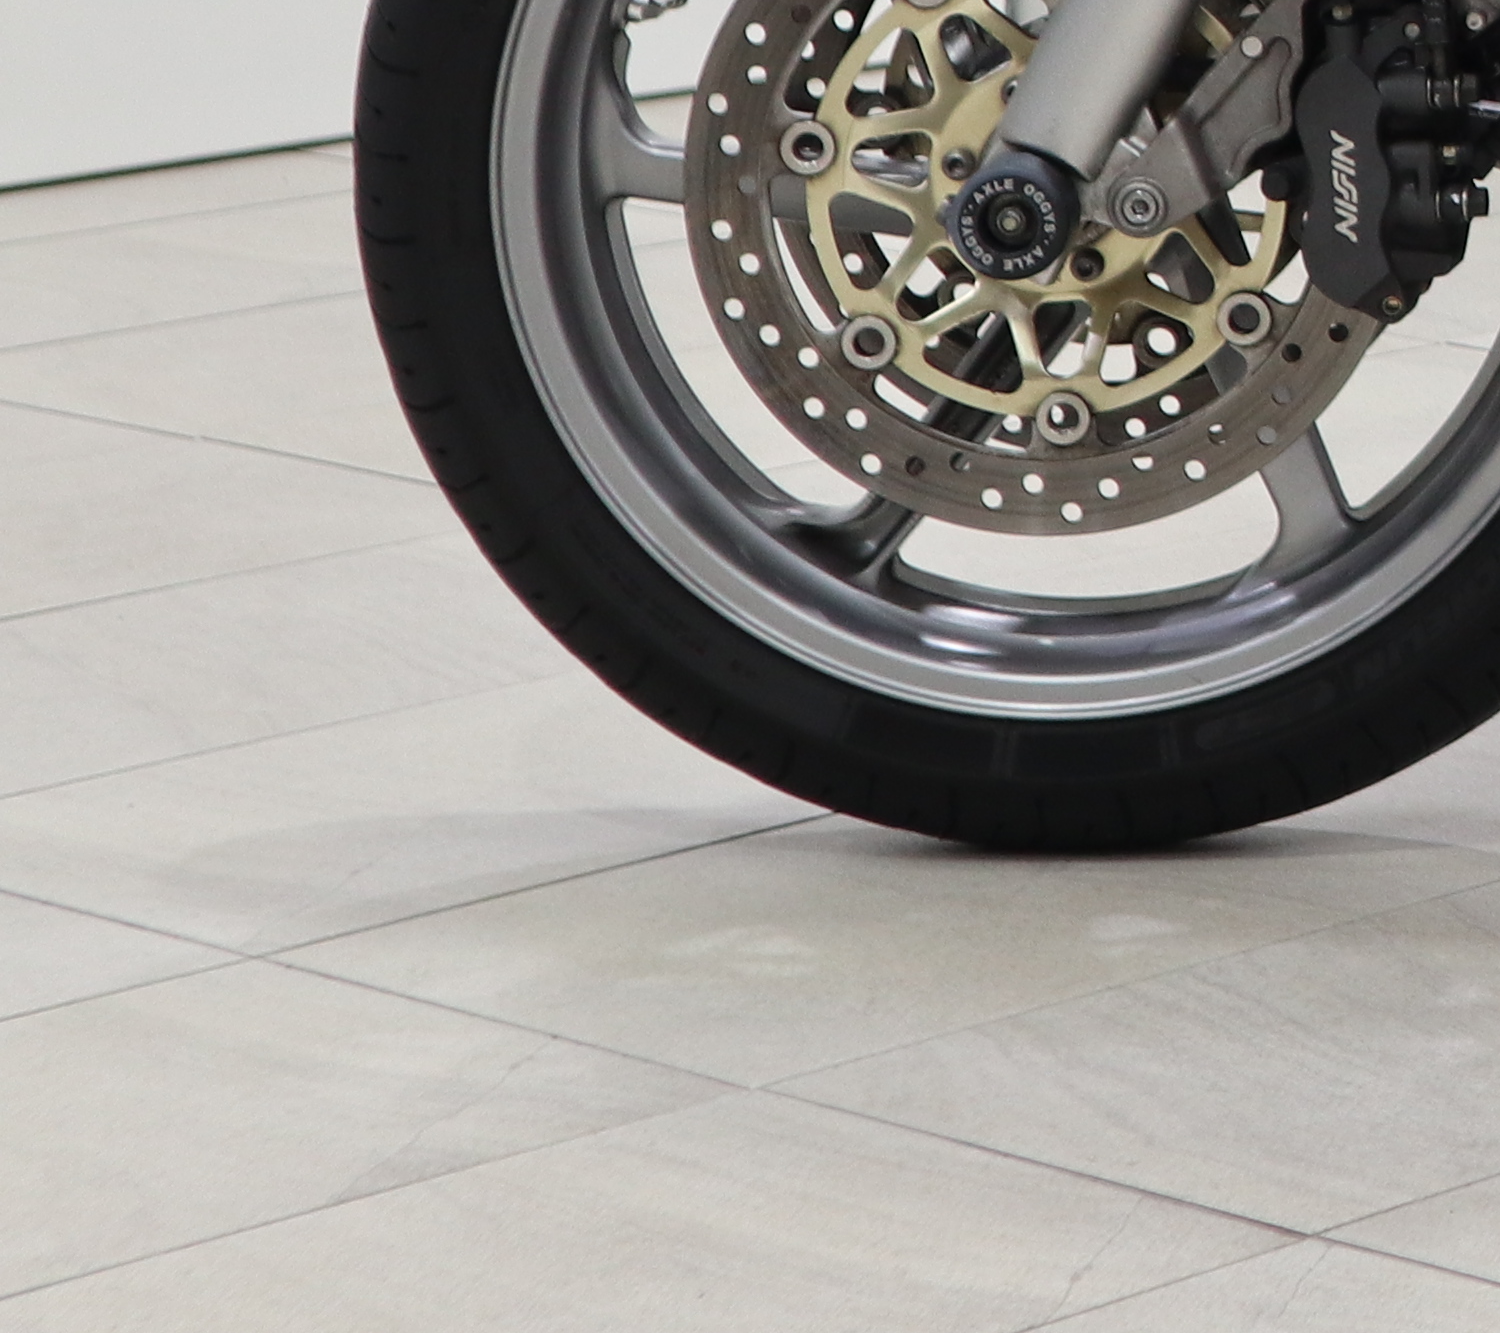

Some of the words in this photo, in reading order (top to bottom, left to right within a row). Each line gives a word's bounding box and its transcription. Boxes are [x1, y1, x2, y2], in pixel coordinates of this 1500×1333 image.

[973, 177, 1015, 206] AXLE
[1023, 183, 1056, 234] OGGYS
[1329, 129, 1360, 244] NISSIN
[960, 215, 995, 267] OGGYS
[1002, 244, 1045, 273] AXLE
